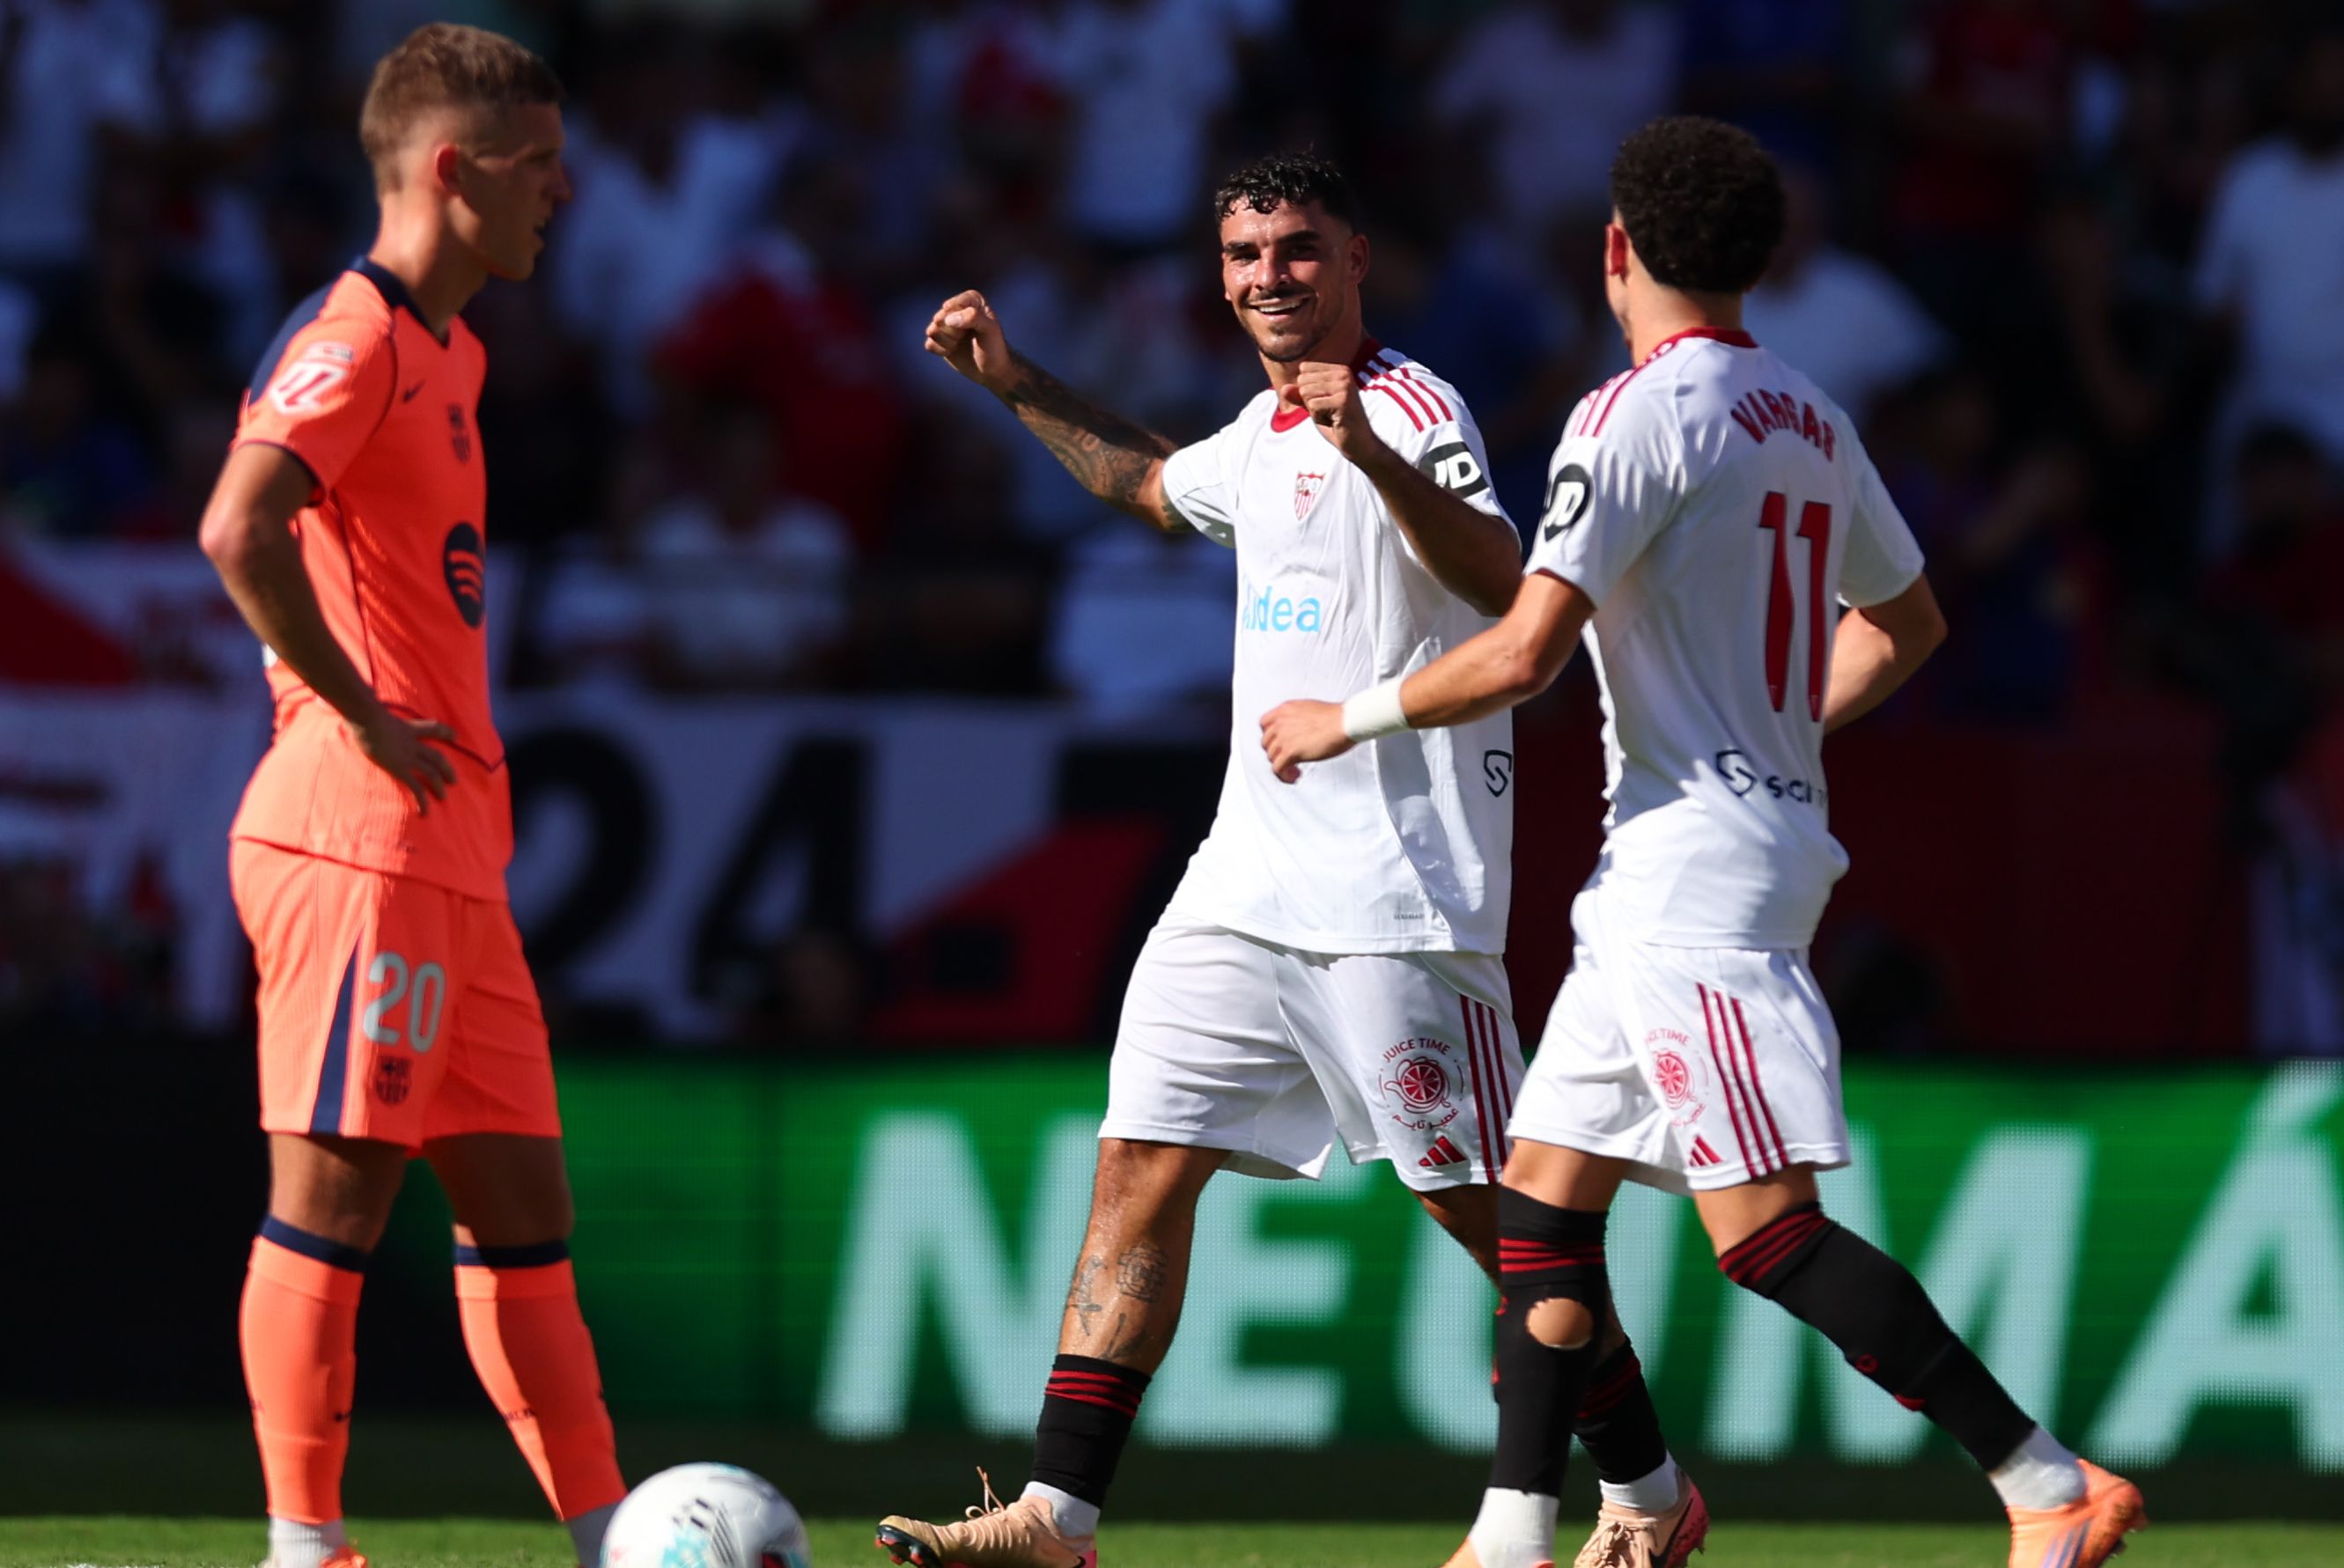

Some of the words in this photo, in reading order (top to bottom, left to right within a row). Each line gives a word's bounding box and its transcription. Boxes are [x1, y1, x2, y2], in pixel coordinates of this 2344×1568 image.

[1758, 490, 1832, 723] 11
[363, 951, 446, 1052] 20
[1383, 1039, 1415, 1064] JUICE
[1419, 1038, 1450, 1056] TIME
